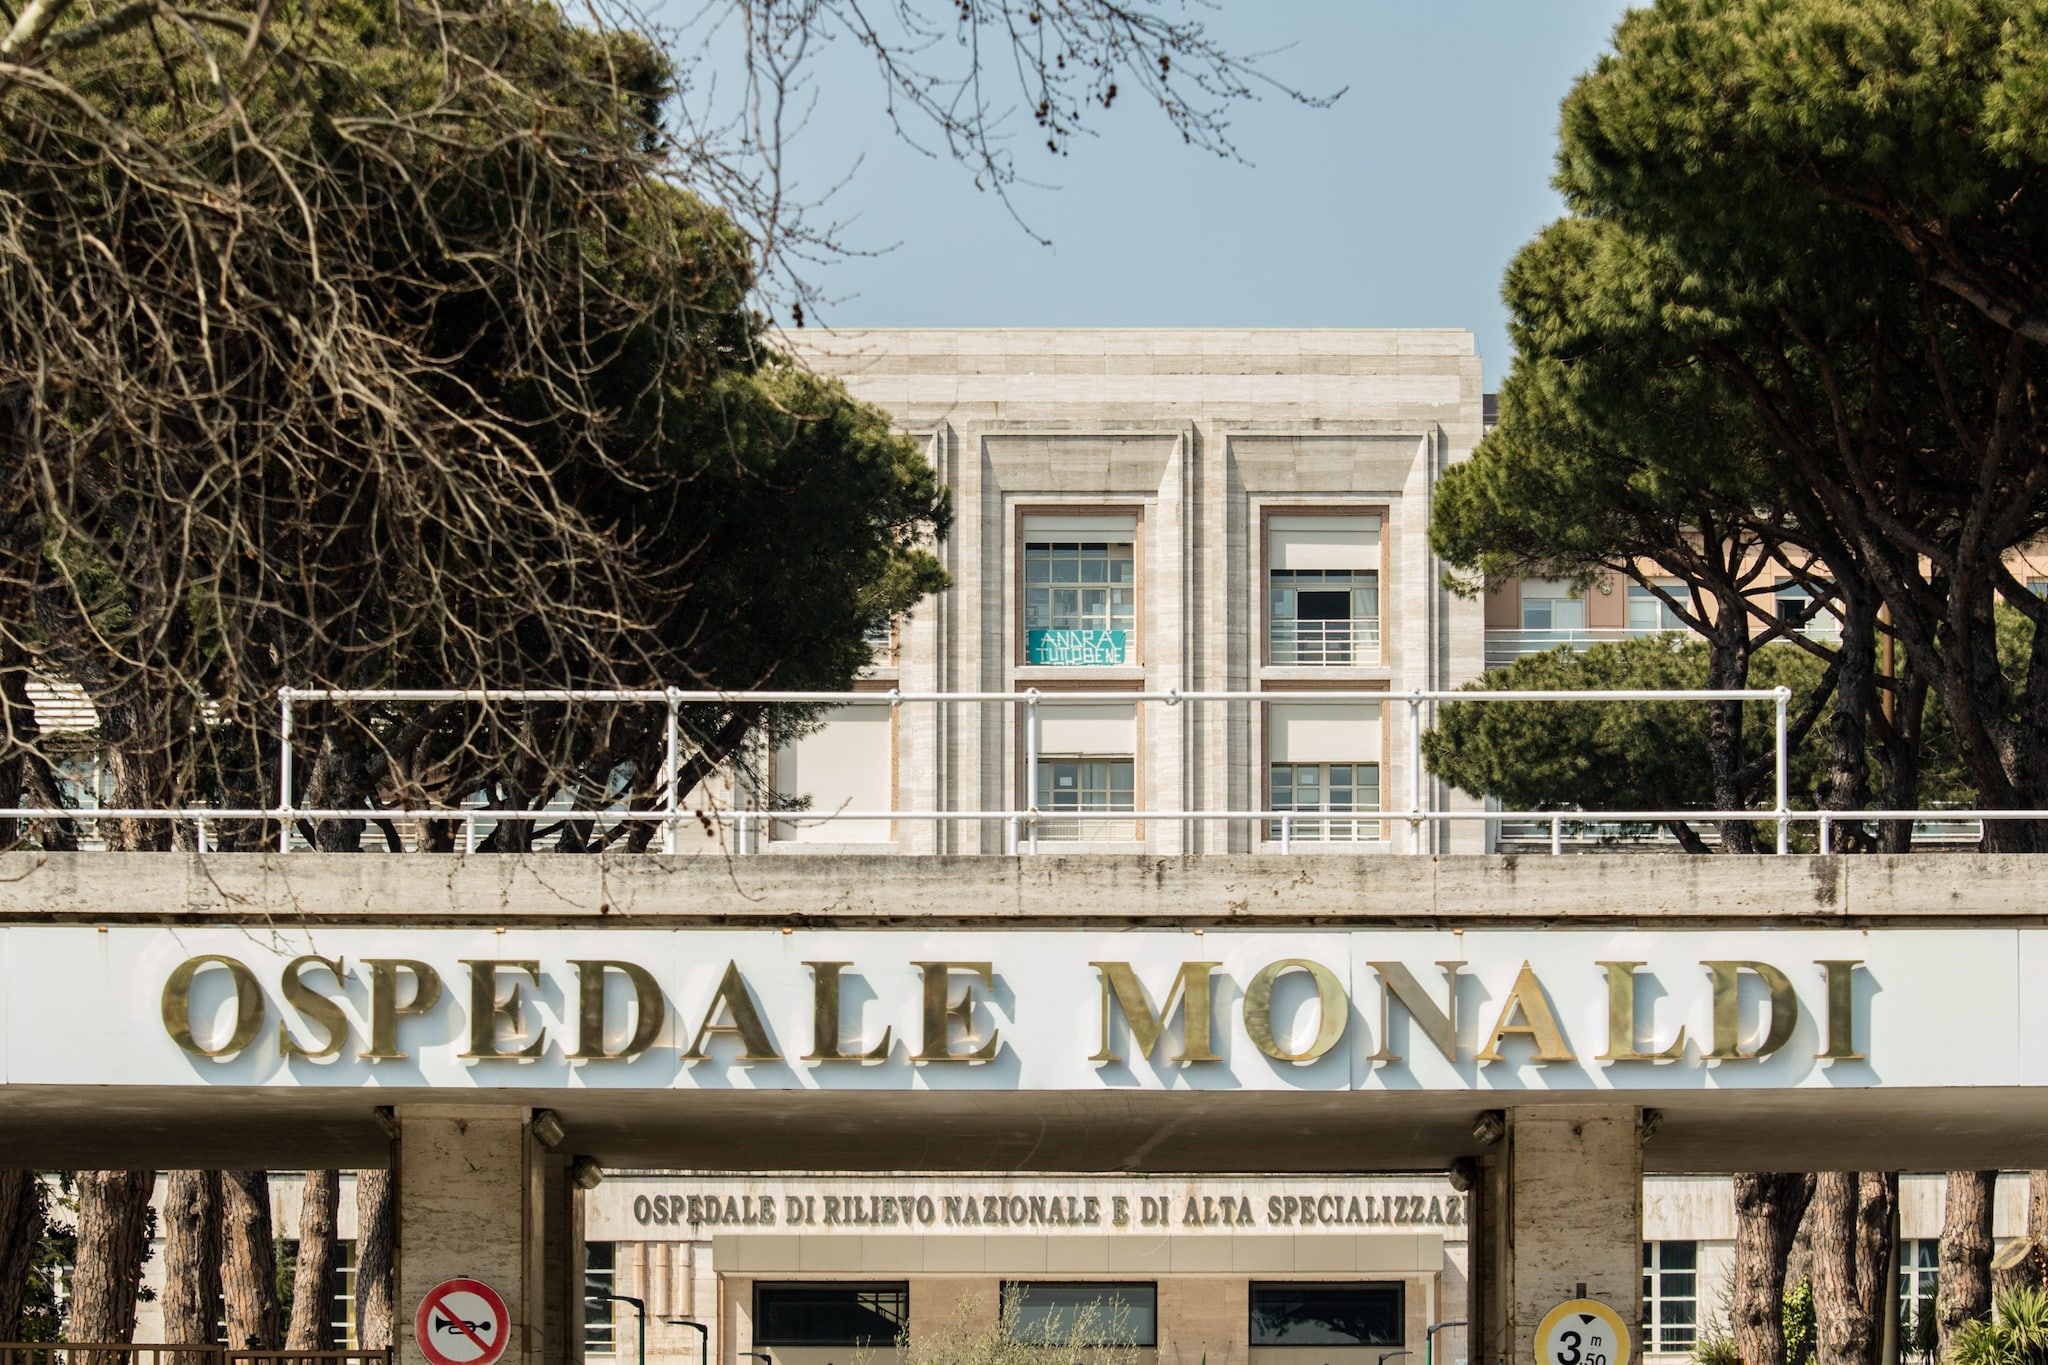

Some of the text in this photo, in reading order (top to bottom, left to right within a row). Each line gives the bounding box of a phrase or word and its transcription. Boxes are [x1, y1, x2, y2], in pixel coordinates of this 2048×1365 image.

[161, 954, 1867, 1062] OSPEDALE MONALDI
[633, 1194, 776, 1225] OSPEDALE
[786, 1195, 815, 1224] DI
[823, 1195, 935, 1224] RILIEVO
[945, 1195, 1101, 1224] NAZIONALE
[1112, 1196, 1128, 1225] E
[1141, 1196, 1170, 1225] DI
[1183, 1196, 1255, 1225] ALTA
